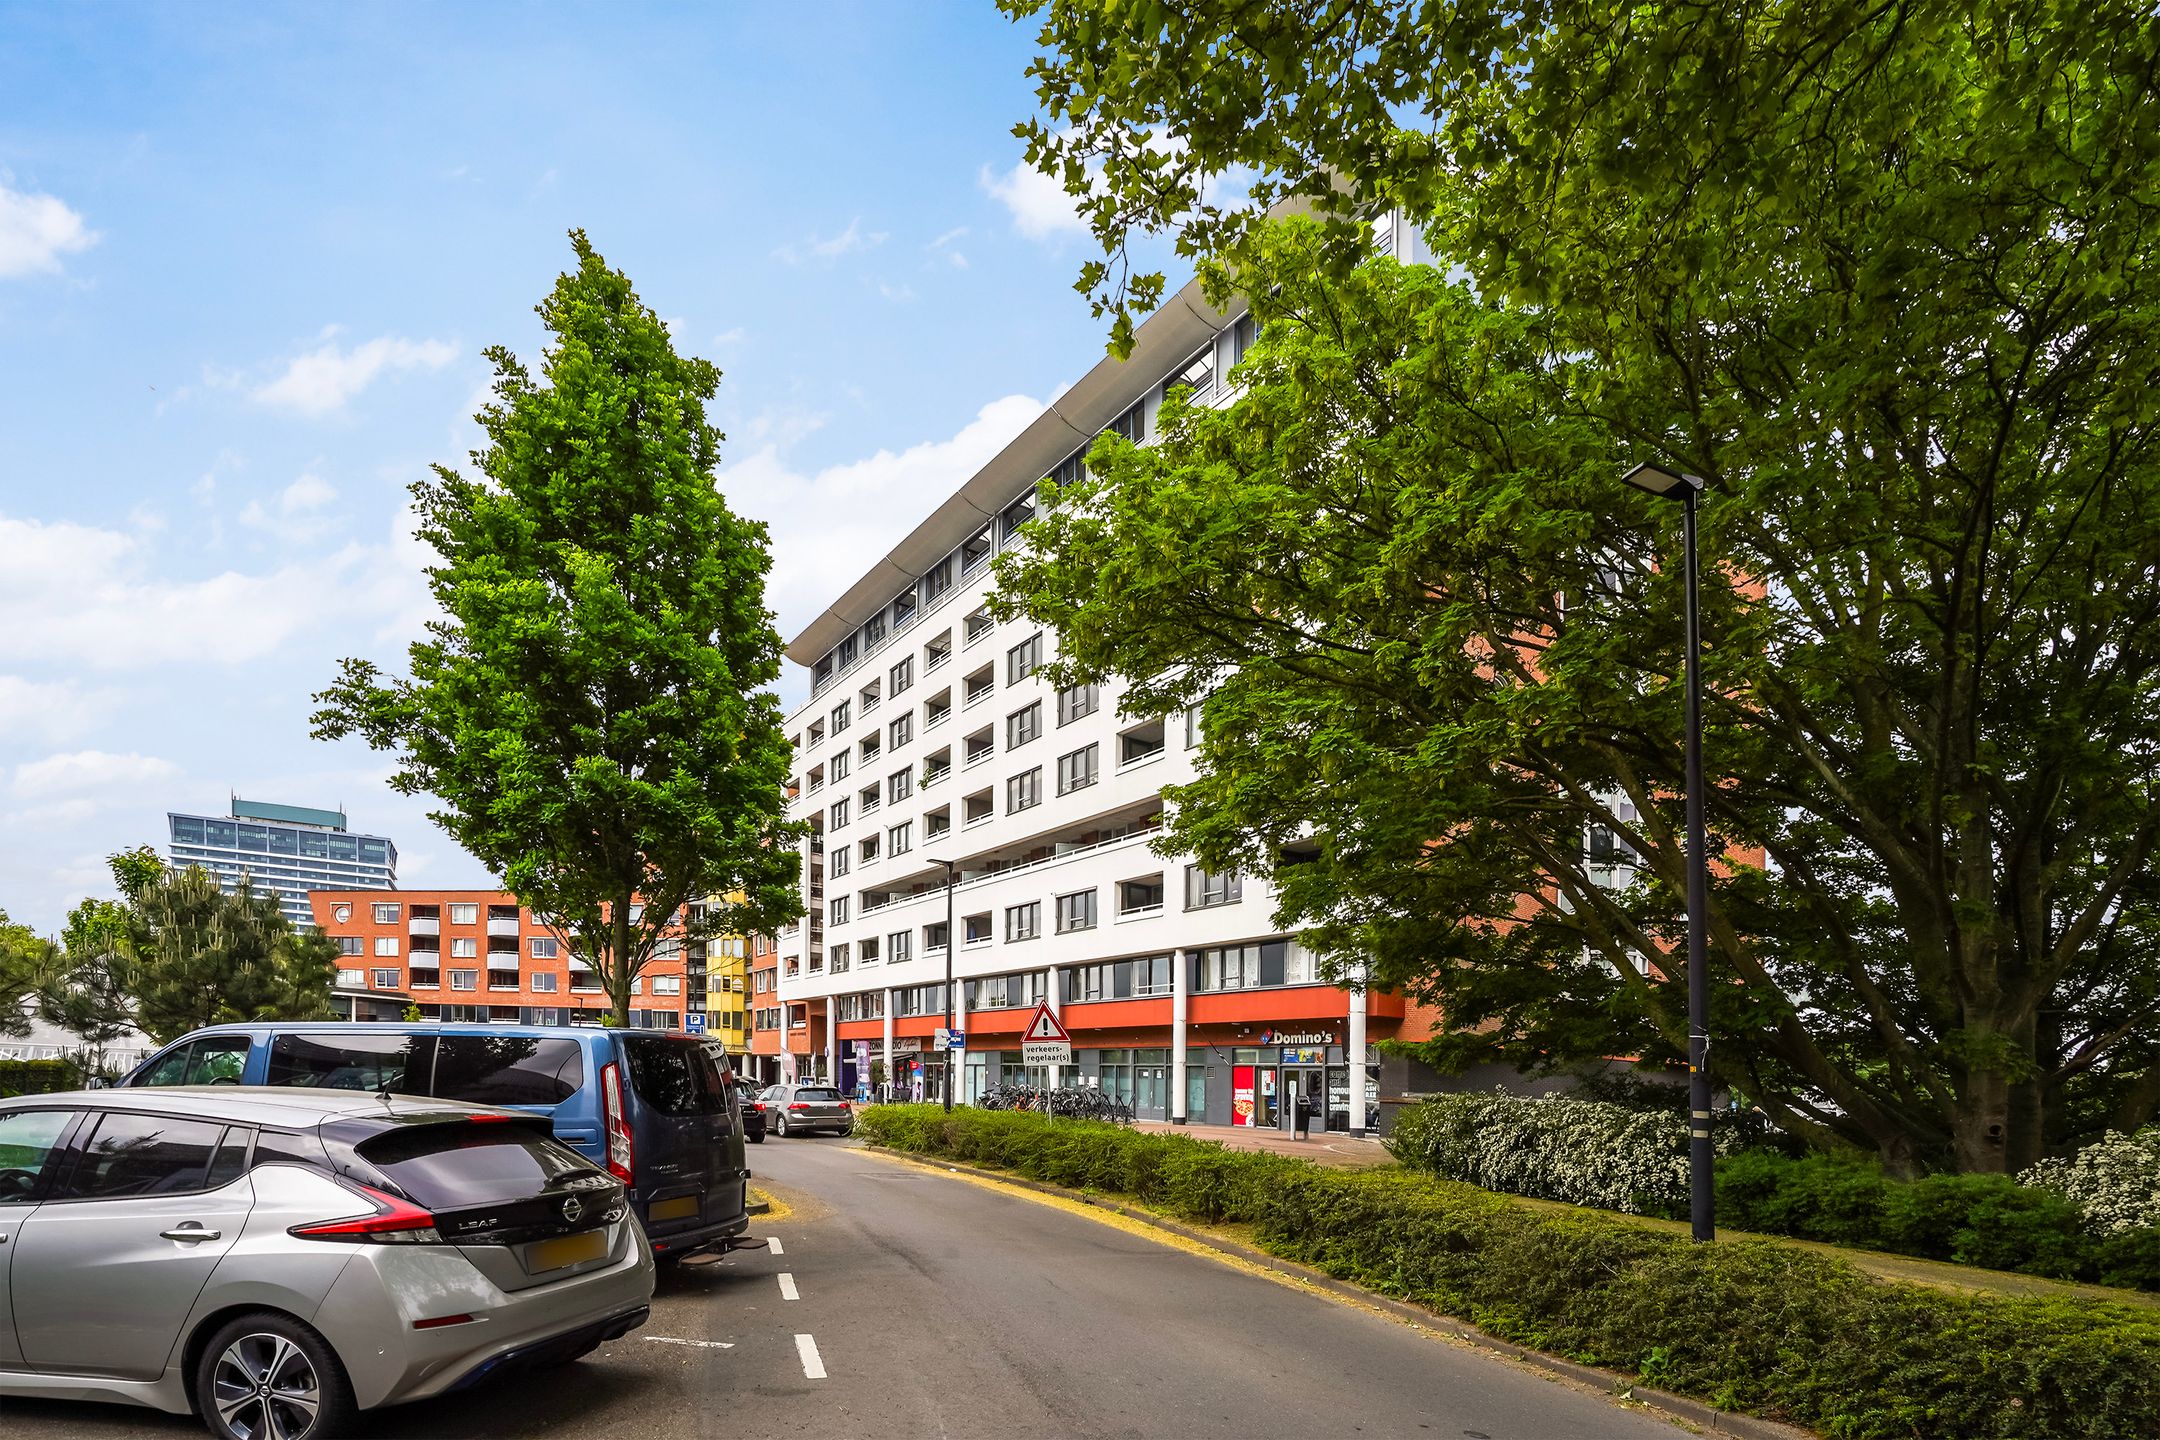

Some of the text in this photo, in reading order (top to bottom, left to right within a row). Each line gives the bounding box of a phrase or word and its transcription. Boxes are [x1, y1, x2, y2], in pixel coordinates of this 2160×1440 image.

[1273, 1030, 1333, 1045] Domino's
[1027, 1054, 1070, 1063] regelaar(s)
[1329, 1086, 1350, 1095] honou
[1329, 1103, 1350, 1111] cravin
[458, 1218, 498, 1230] LEAF
